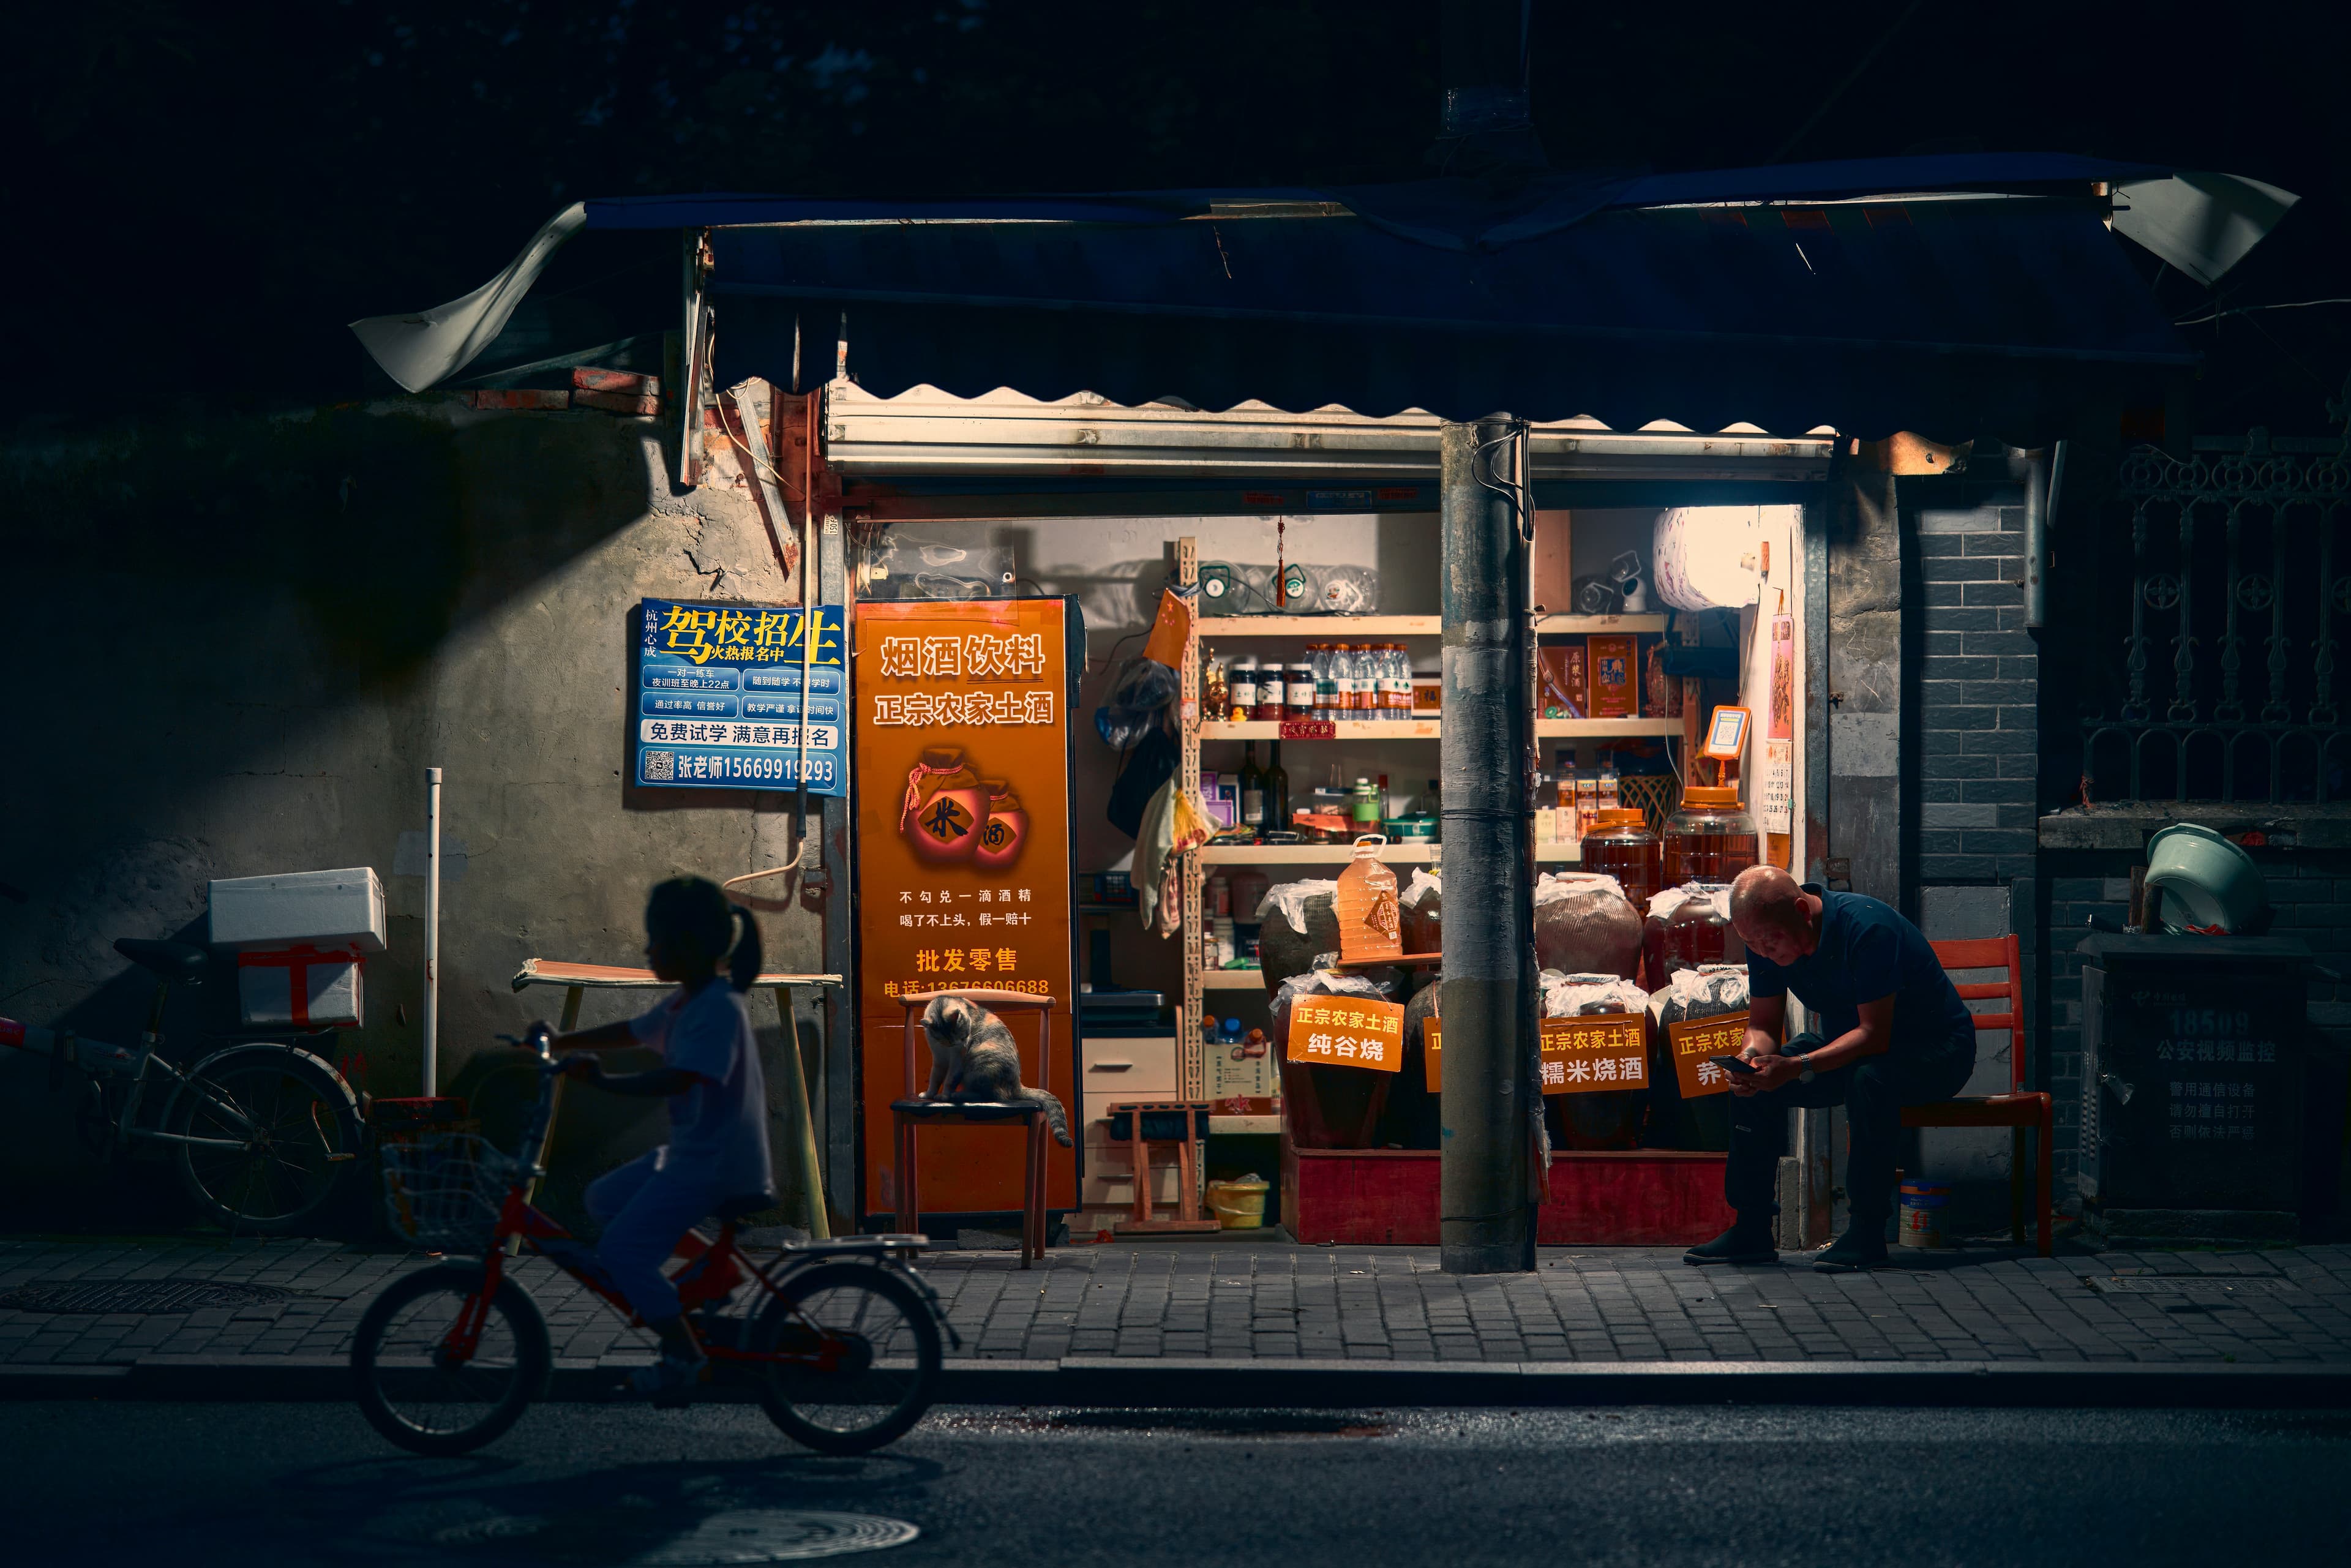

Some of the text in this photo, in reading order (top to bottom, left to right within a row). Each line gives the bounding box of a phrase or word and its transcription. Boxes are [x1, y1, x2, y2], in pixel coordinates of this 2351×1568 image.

[643, 609, 658, 658] 杭州心成
[659, 605, 841, 666] 驾校招生
[710, 645, 786, 662] 火热报名中
[880, 634, 1046, 677] 烟酒饮料
[651, 678, 730, 689] 夜训班至晚上22点
[667, 669, 715, 678] 一对一练车
[752, 676, 830, 688] 随到随学 不学时
[654, 700, 726, 711] 通过率高 信誉好
[747, 703, 785, 713] 教学严谨
[874, 691, 1054, 726] 正宗农家土酒
[650, 722, 829, 746] 免费试学 满意再报名
[926, 798, 969, 837] 米
[983, 824, 1005, 846] 酒
[899, 888, 1032, 904] 不勾兑一滴酒精
[916, 947, 1018, 973] 批发零售
[1297, 1007, 1399, 1035] 正宗农家土酒
[1307, 1032, 1384, 1062] 纯谷烧
[1541, 1028, 1641, 1052] 正宗农家土酒
[2156, 1038, 2278, 1063] 公安视频监控
[1542, 1056, 1643, 1085] 糯米烧酒
[2169, 1081, 2255, 1098] 警用通信设备
[2169, 1103, 2255, 1119] 请勿擅自打开
